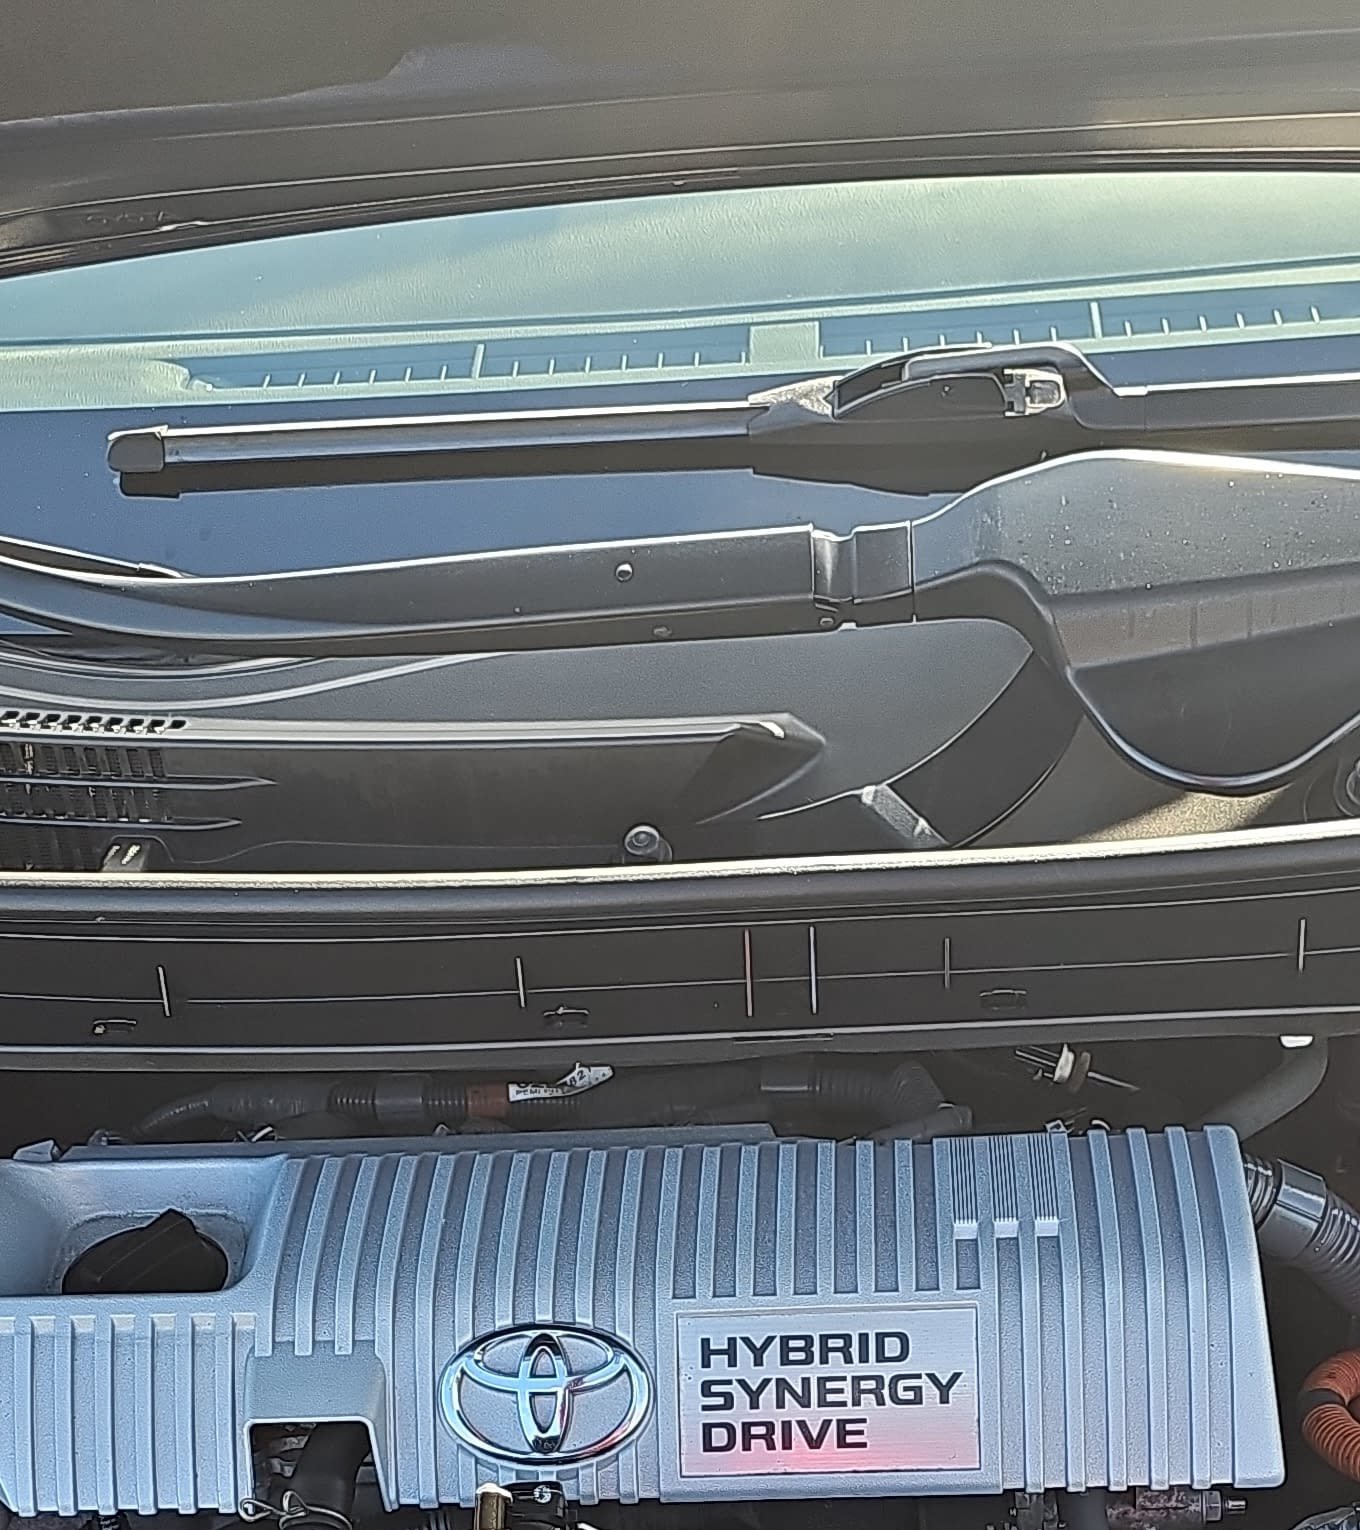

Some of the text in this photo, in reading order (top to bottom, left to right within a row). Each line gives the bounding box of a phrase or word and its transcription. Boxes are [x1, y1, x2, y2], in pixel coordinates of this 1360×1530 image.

[700, 1331, 910, 1369] HYBRID
[700, 1372, 964, 1411] SYNERGY
[702, 1418, 868, 1453] DRIVE
